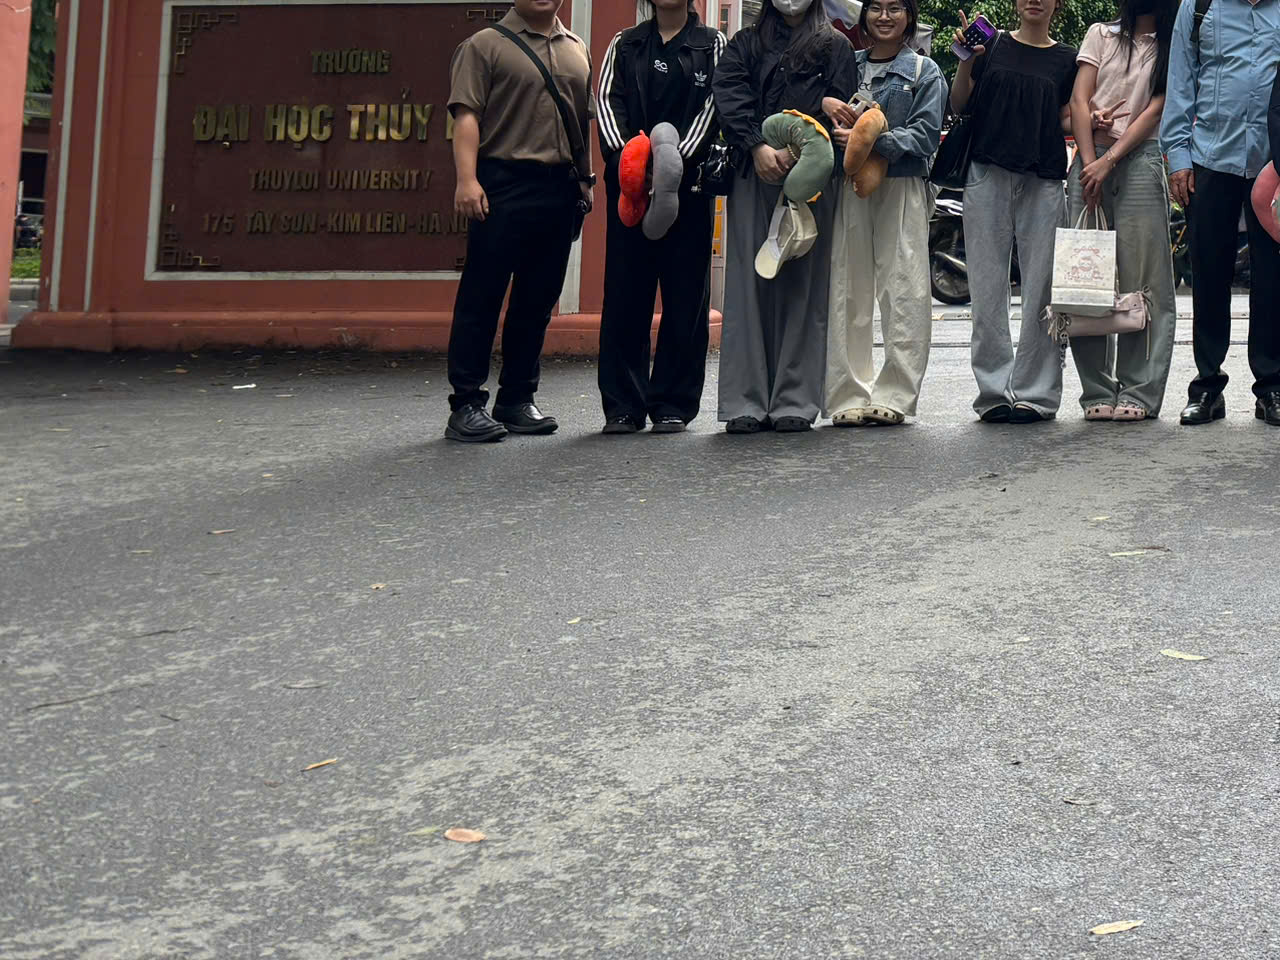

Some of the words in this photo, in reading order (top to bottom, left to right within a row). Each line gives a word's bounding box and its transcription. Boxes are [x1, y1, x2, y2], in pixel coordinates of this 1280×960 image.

[193, 104, 250, 148] ĐẠI
[264, 103, 335, 149] HỌC
[327, 170, 433, 191] UNIVERSITY
[202, 213, 234, 233] 175
